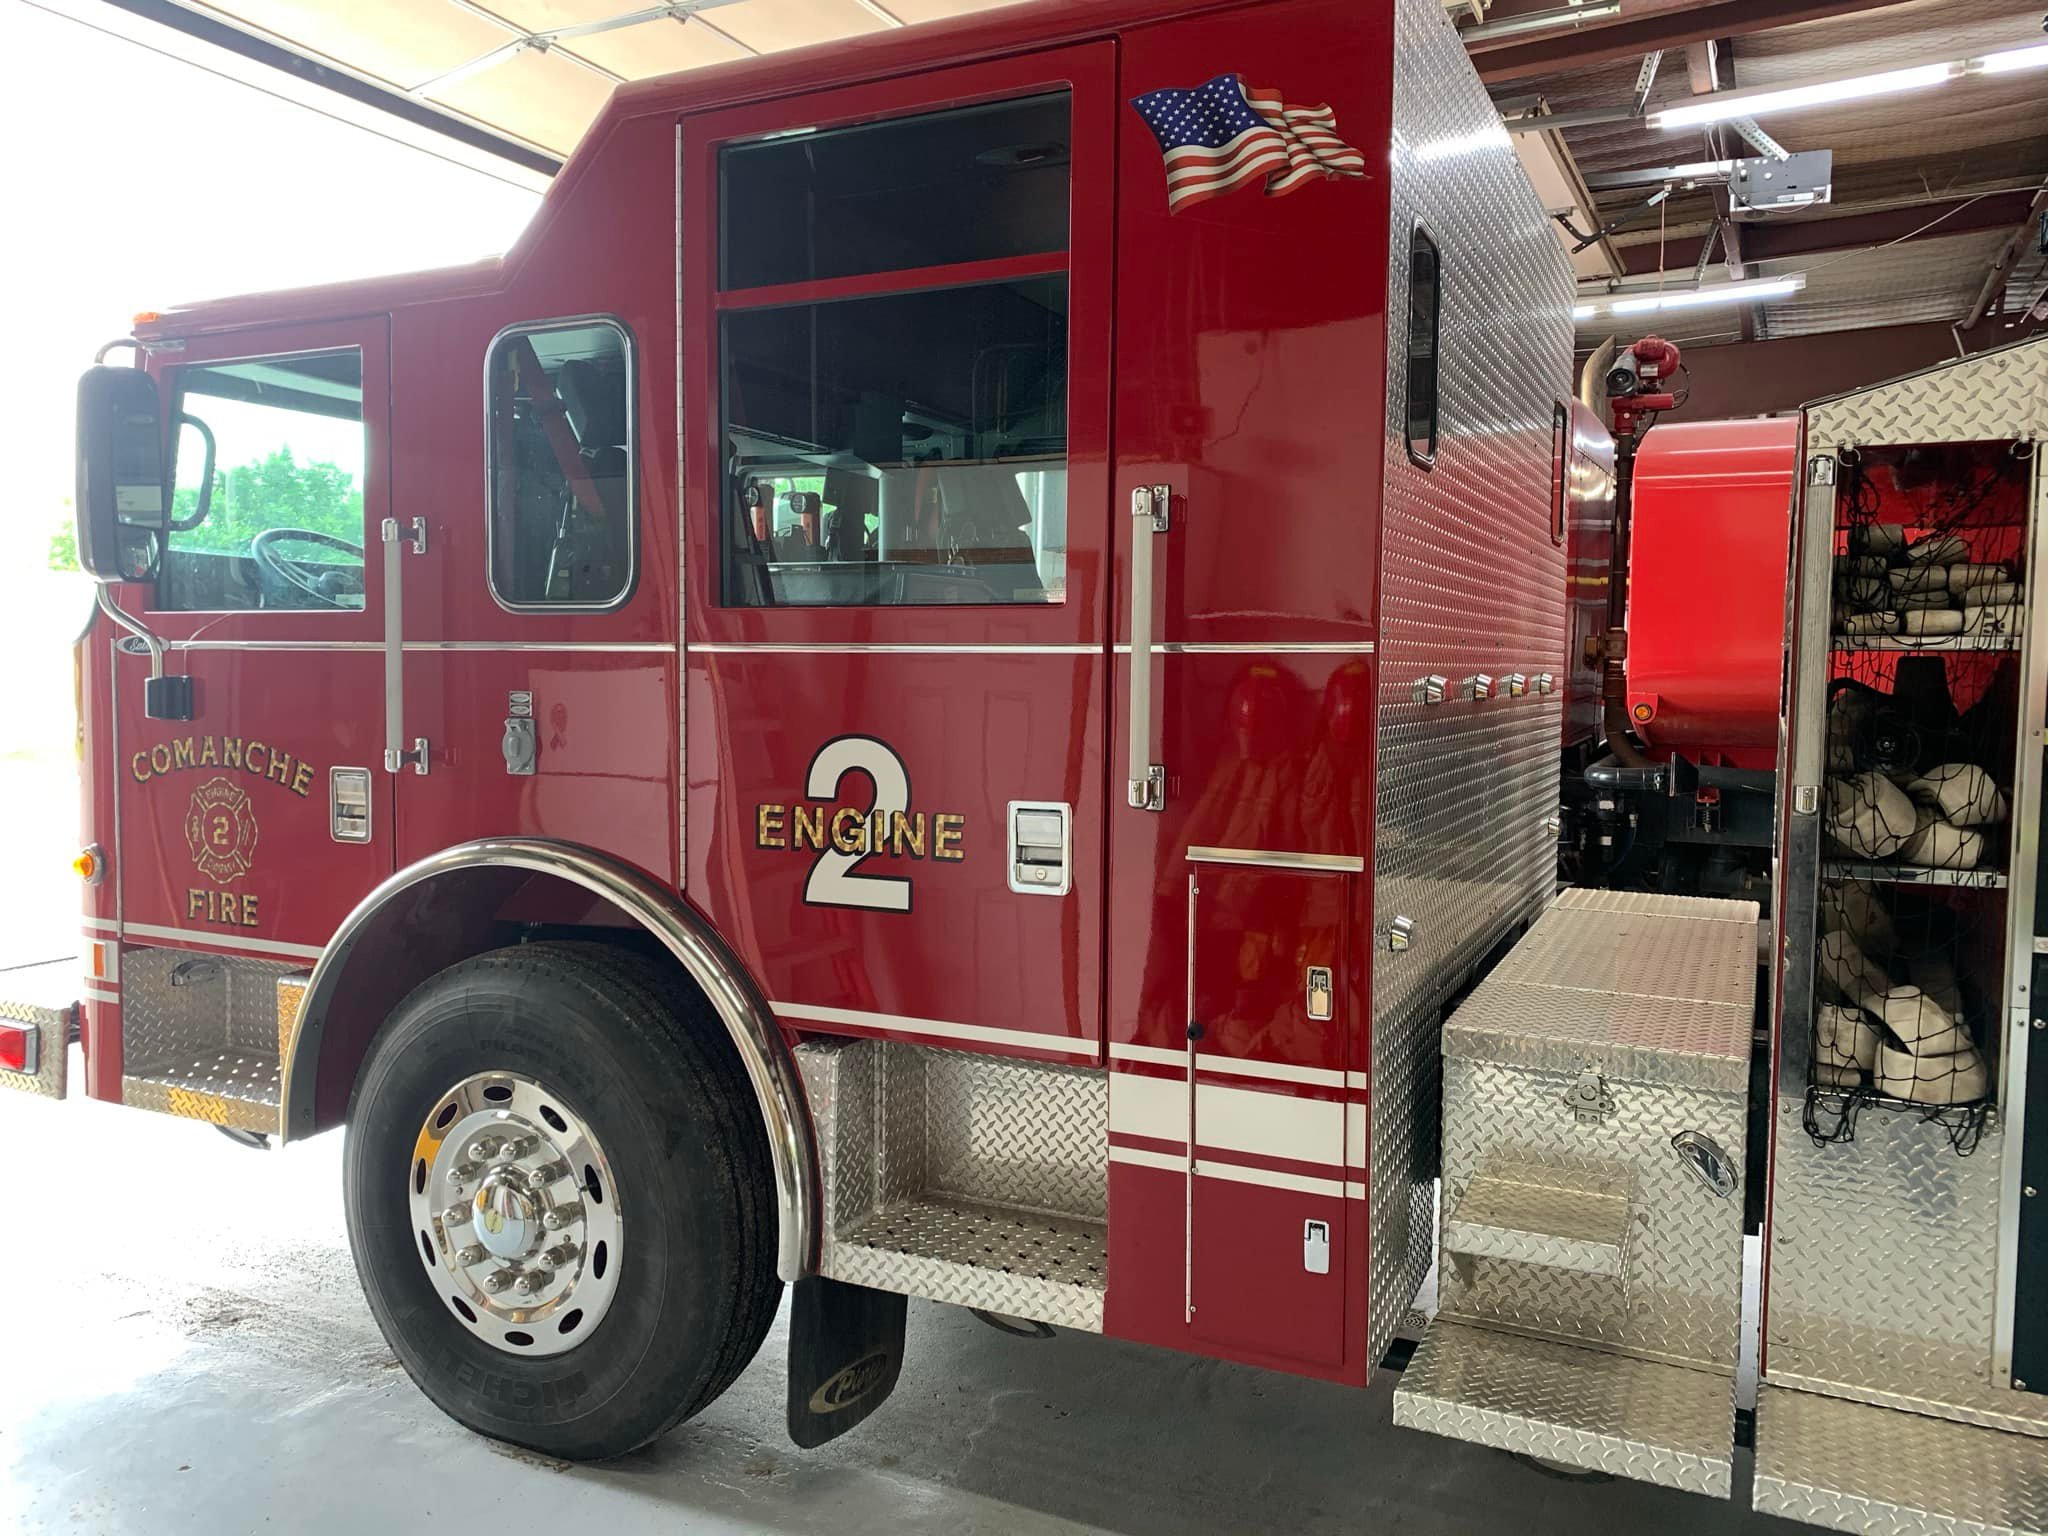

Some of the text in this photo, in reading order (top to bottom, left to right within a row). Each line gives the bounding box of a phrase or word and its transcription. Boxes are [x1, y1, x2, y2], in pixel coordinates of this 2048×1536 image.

[131, 735, 315, 797] COMANCHE
[212, 816, 230, 845] 2
[757, 803, 965, 861] ENGINE
[804, 734, 911, 914] 2
[187, 887, 260, 927] FIRE
